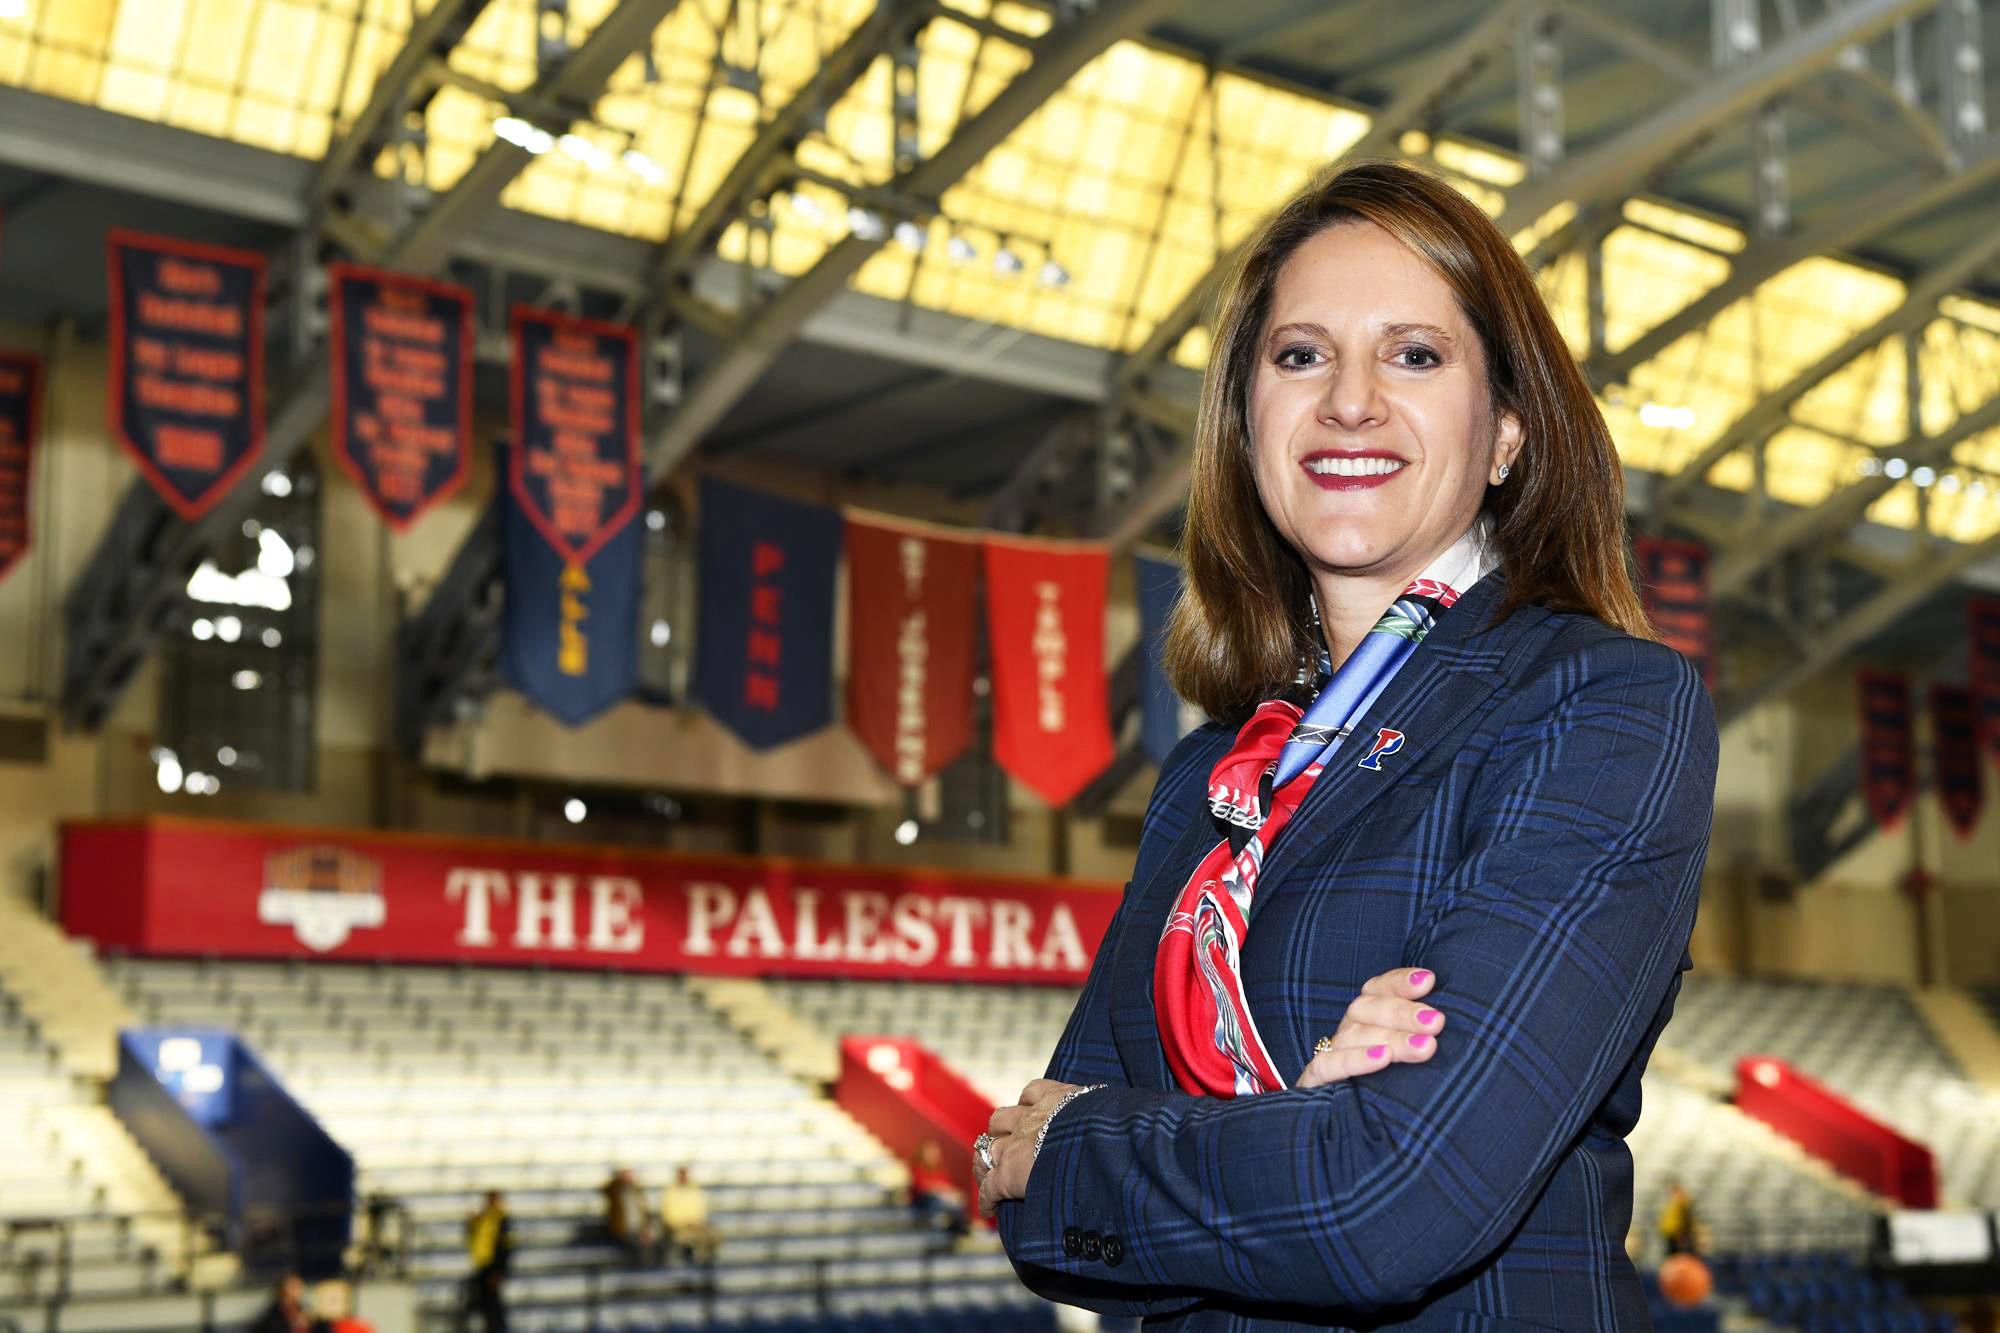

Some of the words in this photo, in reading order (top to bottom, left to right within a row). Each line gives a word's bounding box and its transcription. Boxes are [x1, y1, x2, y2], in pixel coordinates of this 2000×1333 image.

[747, 543, 784, 711] PENN
[1358, 728, 1405, 771] P
[445, 867, 645, 953] THE
[684, 881, 1089, 971] PALESTRA
